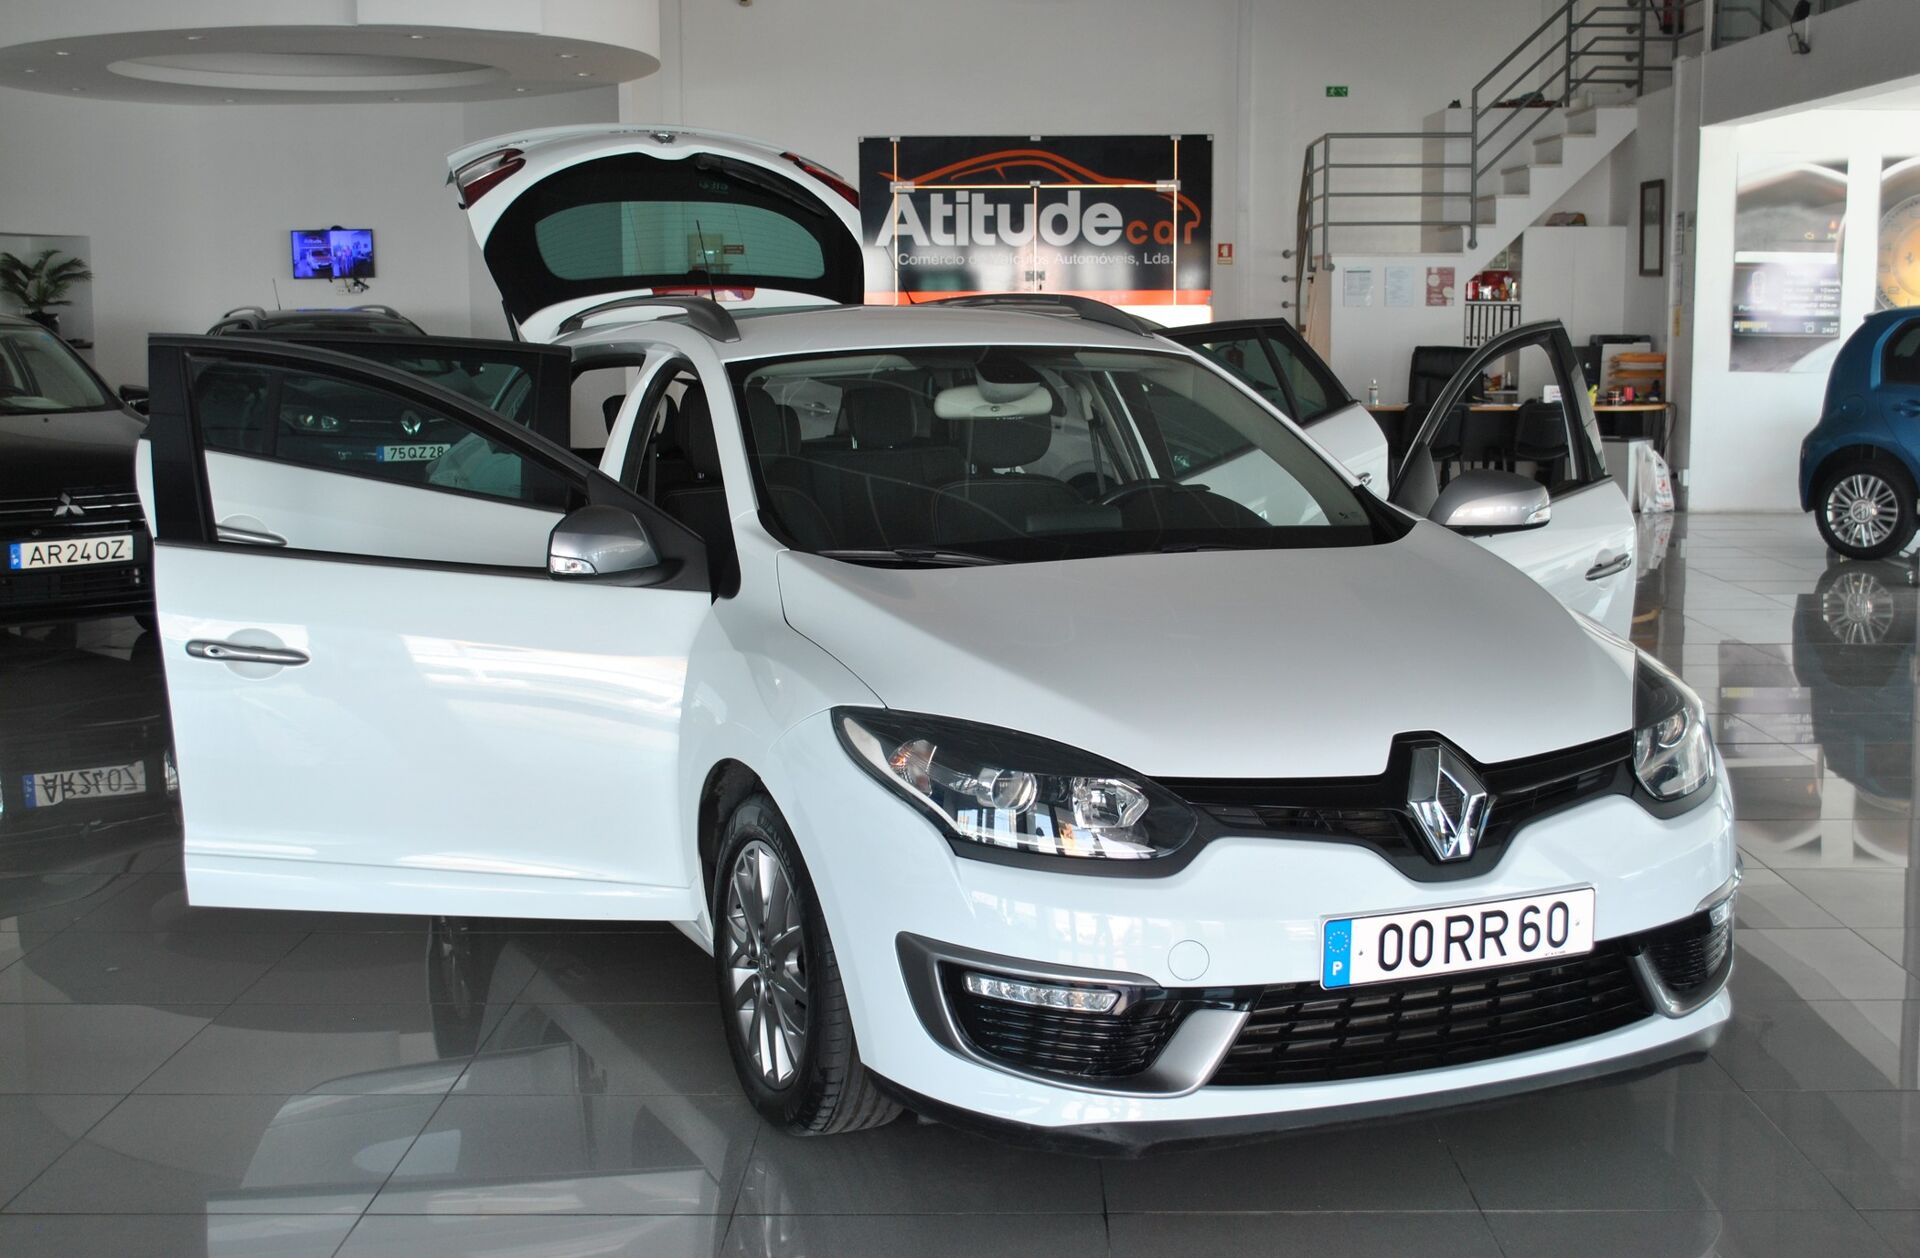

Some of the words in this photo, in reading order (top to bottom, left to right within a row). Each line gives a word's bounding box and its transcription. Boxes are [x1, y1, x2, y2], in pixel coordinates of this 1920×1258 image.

[875, 190, 1123, 247] Atitude
[898, 252, 964, 266] Comércio
[1055, 252, 1139, 267] Automóveis,
[1144, 253, 1174, 265] Lda.
[390, 446, 444, 460] 75QZ28
[1332, 960, 1344, 976] P
[1378, 900, 1569, 972] 00RR60
